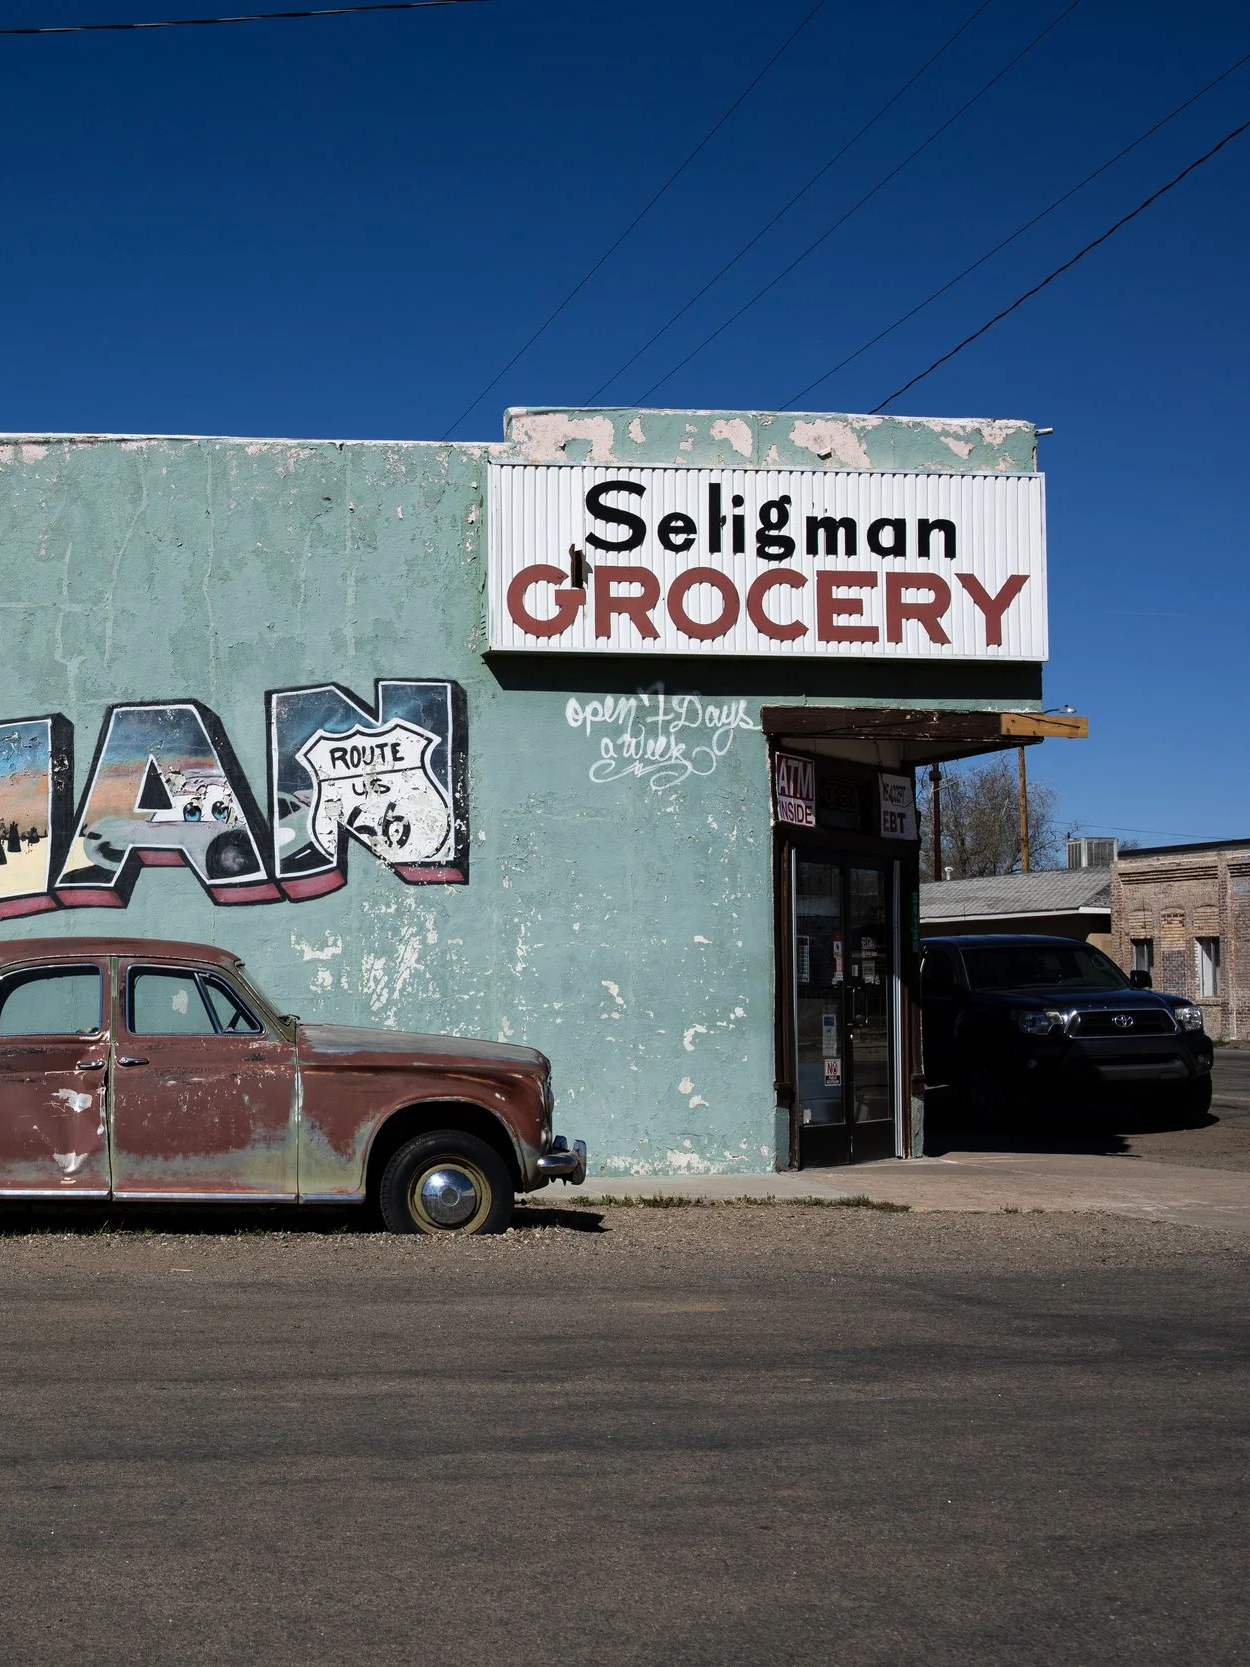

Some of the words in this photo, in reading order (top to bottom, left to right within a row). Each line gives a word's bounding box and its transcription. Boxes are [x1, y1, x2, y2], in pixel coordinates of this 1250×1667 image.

[585, 479, 958, 561] Seligman
[507, 563, 1031, 646] GROCERY
[669, 692, 763, 756] Days
[330, 742, 405, 770] ROUTE
[601, 736, 617, 759] a
[778, 757, 814, 801] ATM
[779, 801, 813, 825] INSIDE
[883, 810, 907, 834] EBT
